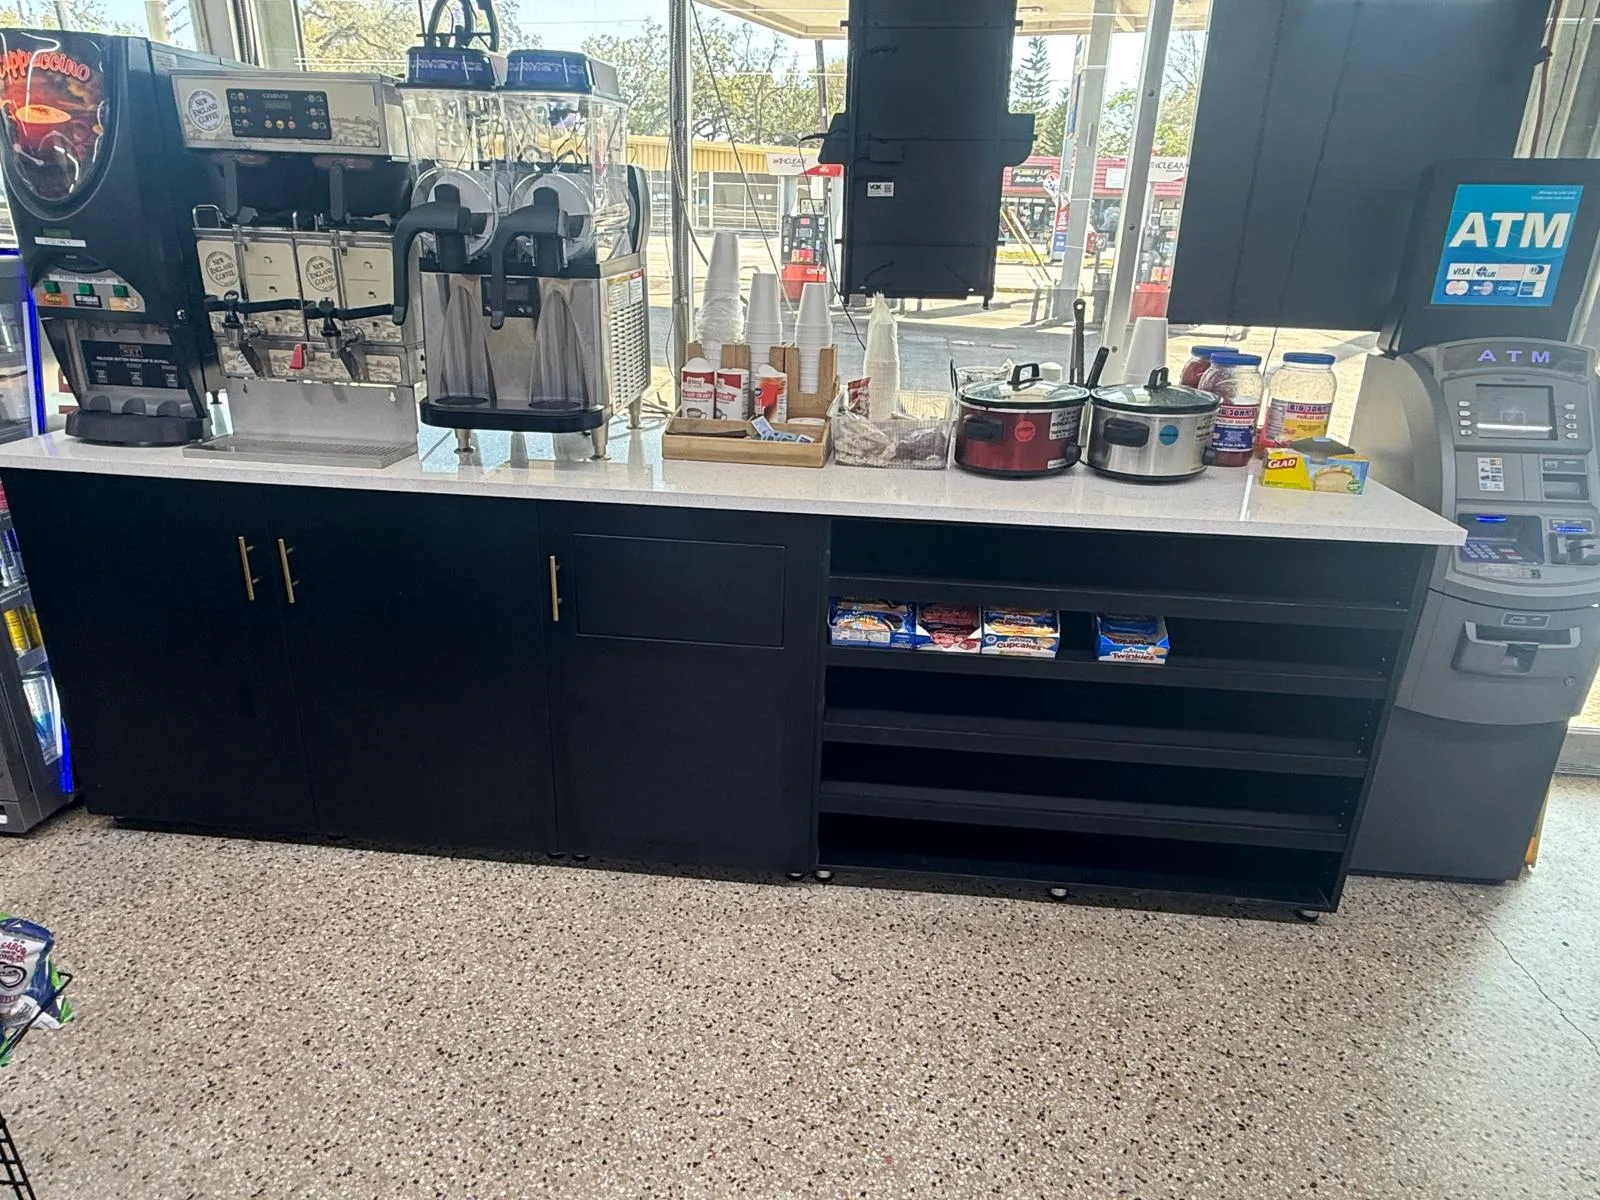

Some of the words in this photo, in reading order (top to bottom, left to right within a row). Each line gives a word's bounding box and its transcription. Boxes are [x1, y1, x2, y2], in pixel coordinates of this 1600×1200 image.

[193, 103, 218, 117] ENGLAND
[1448, 212, 1571, 248] ATM
[208, 262, 234, 275] ENGLAND
[1453, 268, 1471, 276] VISA
[1478, 350, 1550, 363] ATM
[1268, 459, 1296, 469] GLAD
[1111, 652, 1154, 660] Twinkies
